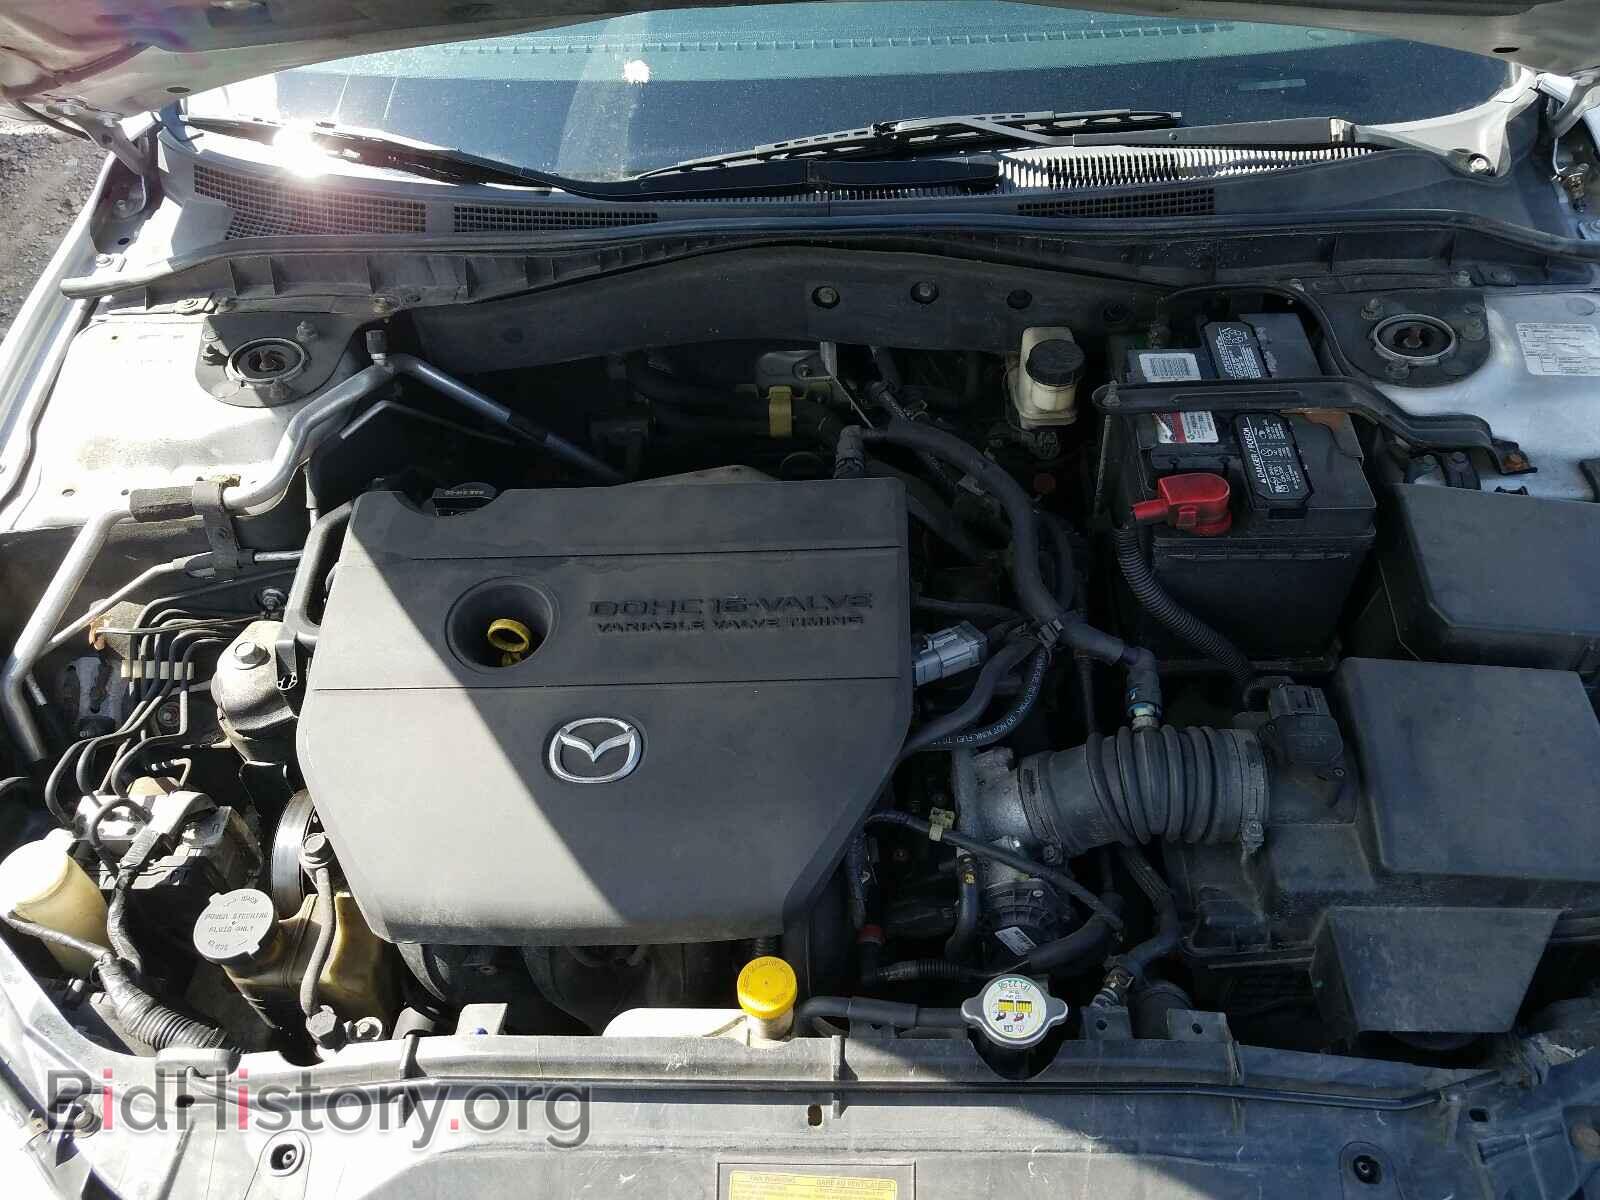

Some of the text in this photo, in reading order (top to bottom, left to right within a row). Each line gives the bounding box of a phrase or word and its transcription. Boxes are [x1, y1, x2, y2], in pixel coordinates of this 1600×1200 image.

[1251, 453, 1266, 478] DANGER
[589, 599, 705, 616] DOHC
[597, 614, 864, 633] VARIABLE VALVE TIMING
